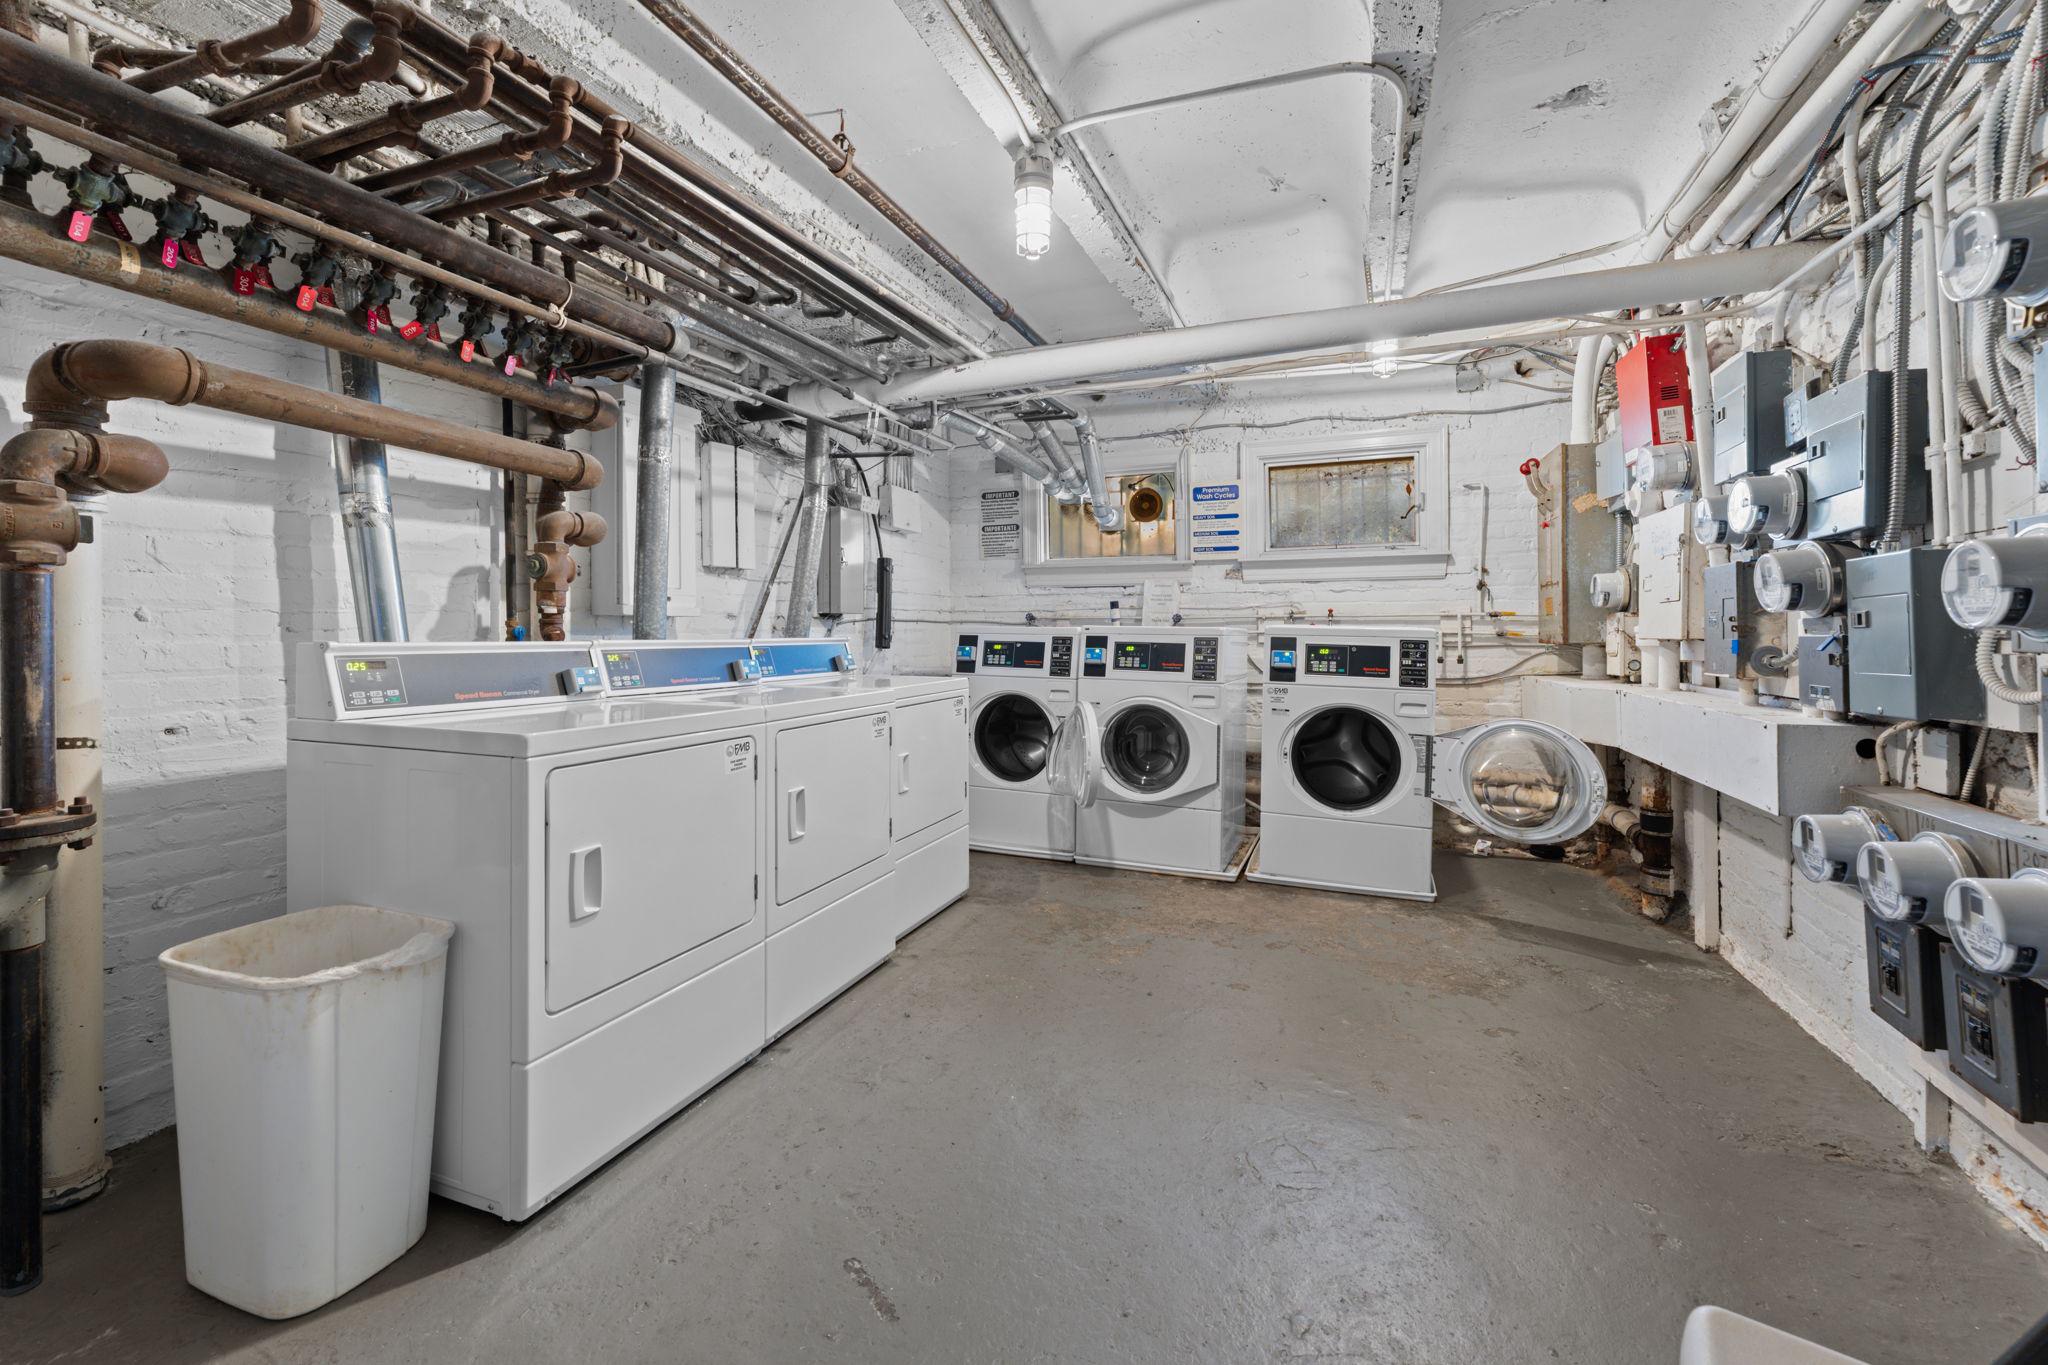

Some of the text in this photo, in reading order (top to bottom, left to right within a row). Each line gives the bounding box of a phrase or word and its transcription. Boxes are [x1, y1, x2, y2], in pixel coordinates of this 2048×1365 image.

[73, 220, 85, 238] 104
[166, 246, 175, 263] 204
[239, 275, 250, 292] 304
[403, 325, 417, 337] 403
[985, 491, 1015, 499] IMPORTANT
